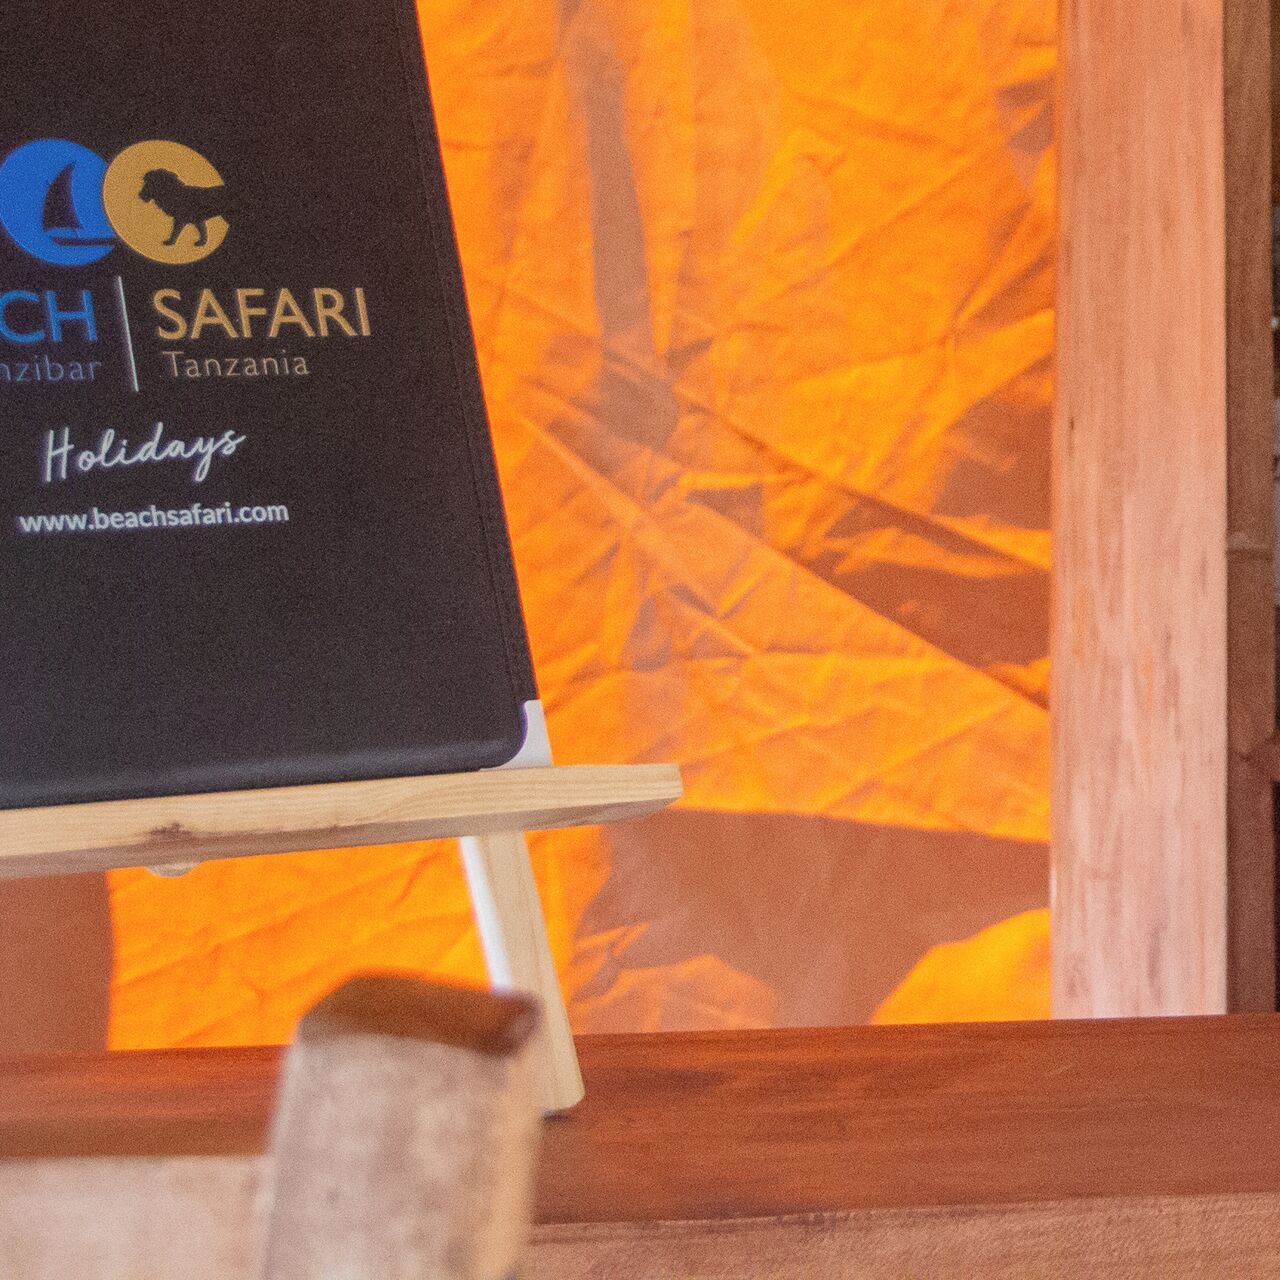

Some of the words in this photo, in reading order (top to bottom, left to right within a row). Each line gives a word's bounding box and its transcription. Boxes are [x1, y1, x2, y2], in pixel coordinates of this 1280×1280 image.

[153, 287, 371, 340] SAFARI
[162, 349, 310, 379] Tanzania
[44, 422, 247, 483] Holidays
[19, 501, 290, 532] www.beachsafari.com
